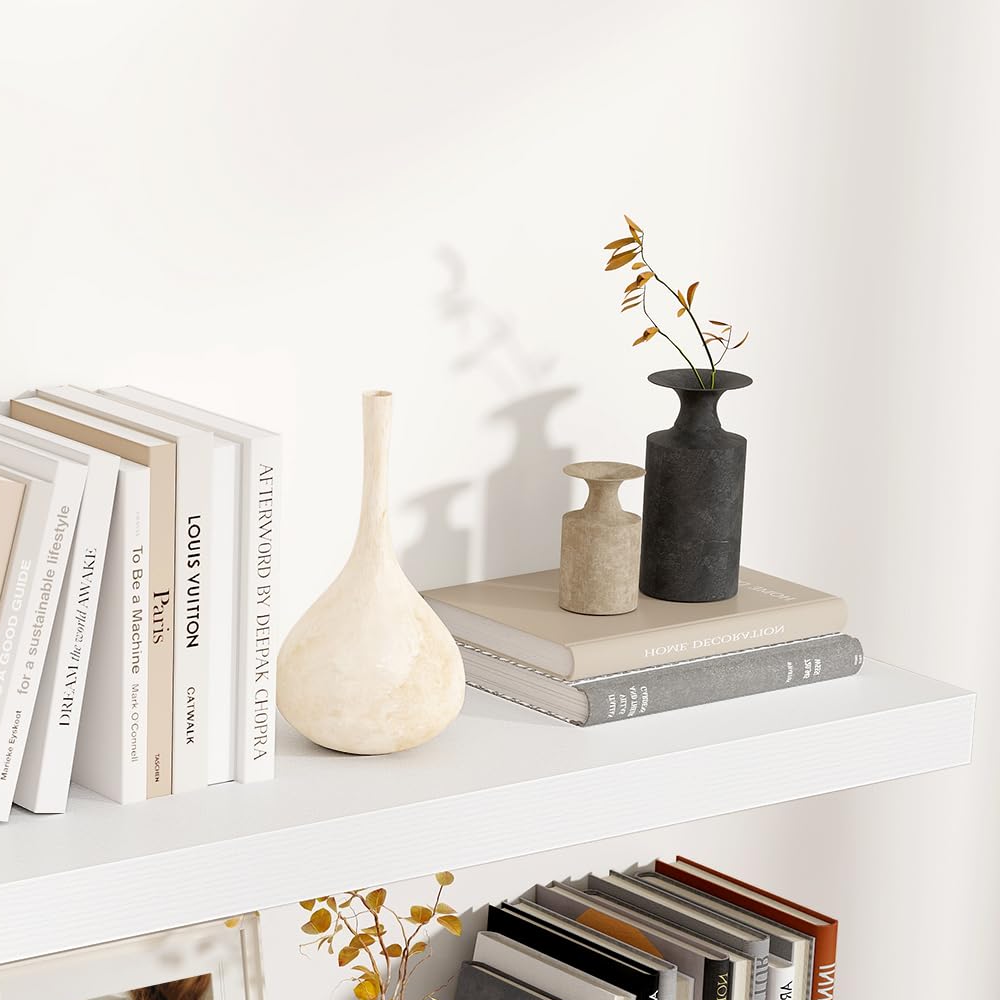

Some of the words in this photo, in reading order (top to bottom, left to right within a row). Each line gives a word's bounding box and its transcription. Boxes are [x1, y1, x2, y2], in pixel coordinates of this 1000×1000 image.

[46, 505, 70, 565] lifestyle
[187, 515, 201, 569] LOUIS
[257, 463, 274, 578] AFTERWORD
[78, 547, 97, 609] AWAKE
[131, 545, 143, 564] To
[131, 569, 143, 590] Be
[0, 615, 18, 665] GOOD
[11, 559, 32, 612] GUIDE
[29, 568, 56, 656] sustainable
[132, 595, 141, 604] a
[152, 590, 170, 644] Paris
[186, 573, 200, 648] VUITTON
[256, 585, 271, 607] BY
[69, 643, 82, 662] the
[73, 609, 88, 644] world
[131, 609, 143, 674] Machine
[255, 614, 270, 683] DEEPAK
[17, 674, 31, 695] for
[25, 660, 35, 670] a
[59, 665, 79, 726] DREAM
[131, 683, 140, 710] Mark
[185, 686, 196, 745] CATWALK
[253, 688, 269, 761] CHOPRA
[0, 746, 15, 781] Marieke
